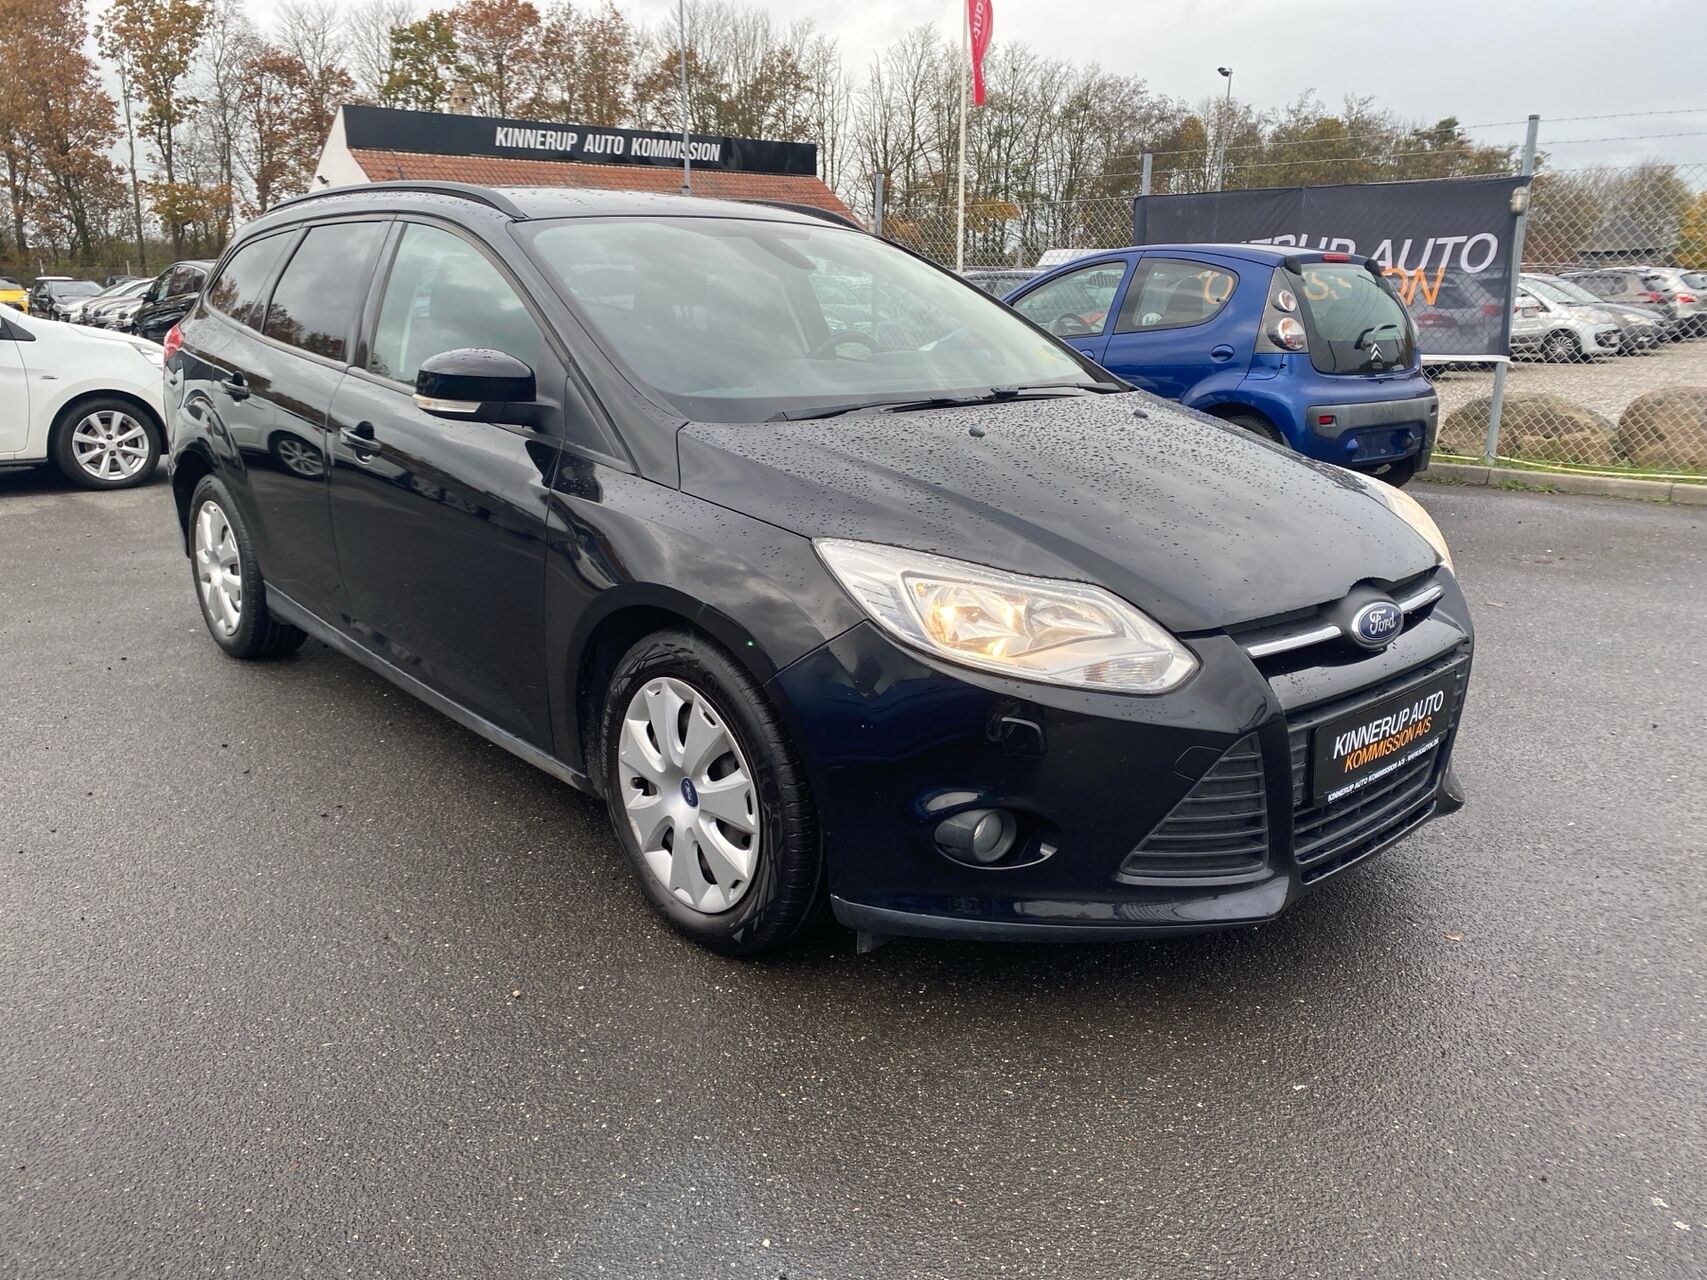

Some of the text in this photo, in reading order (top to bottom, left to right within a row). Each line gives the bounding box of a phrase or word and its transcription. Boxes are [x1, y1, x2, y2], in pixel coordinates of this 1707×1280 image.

[495, 126, 721, 162] KINNERUP AUTO KOMMISSION
[1371, 231, 1498, 277] AUTO
[1369, 608, 1397, 635] Ford
[1333, 708, 1410, 759] KINNERUP
[1409, 690, 1444, 726] AUTO
[1344, 724, 1416, 773] KOMMISSION
[1413, 717, 1432, 738] A/S
